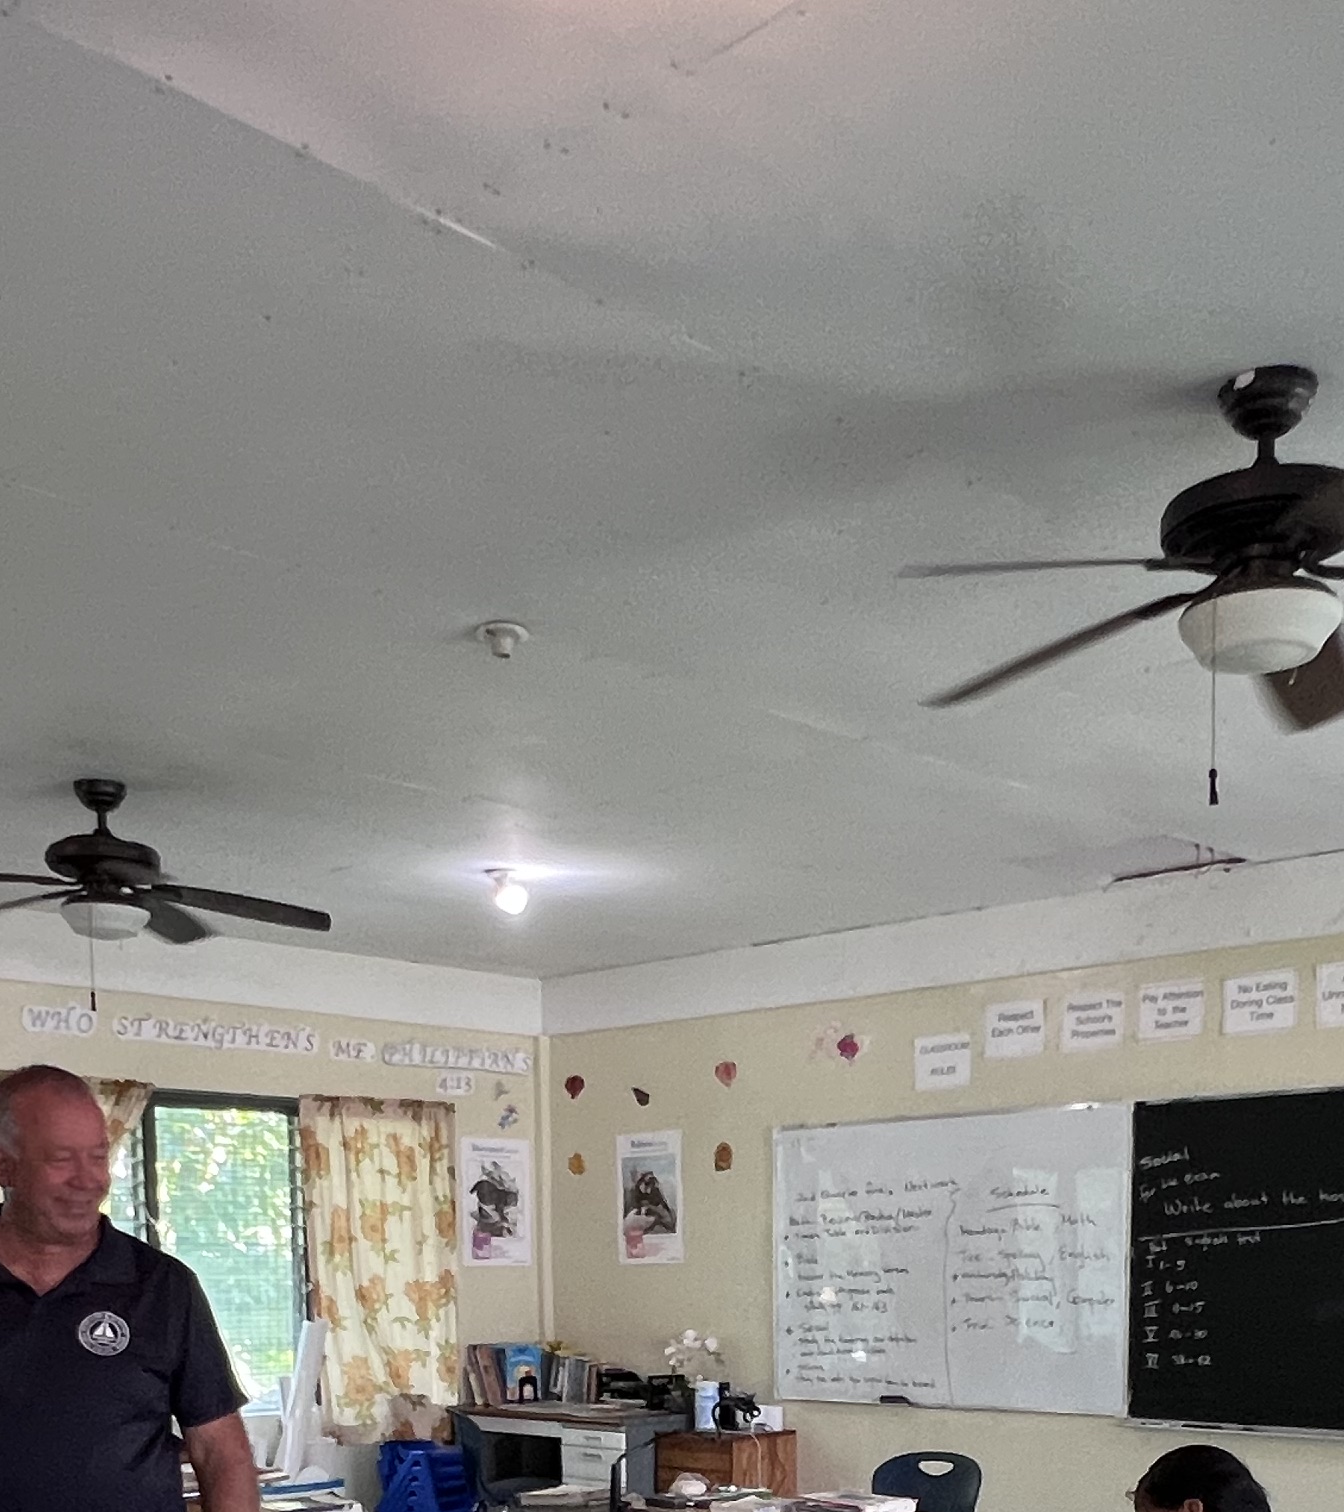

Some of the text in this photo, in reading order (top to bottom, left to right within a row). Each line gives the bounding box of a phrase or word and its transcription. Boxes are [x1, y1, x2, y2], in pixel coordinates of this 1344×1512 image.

[1256, 981, 1288, 993] Eating
[27, 1006, 94, 1034] WHO
[117, 1013, 316, 1053] STRENGTHENS
